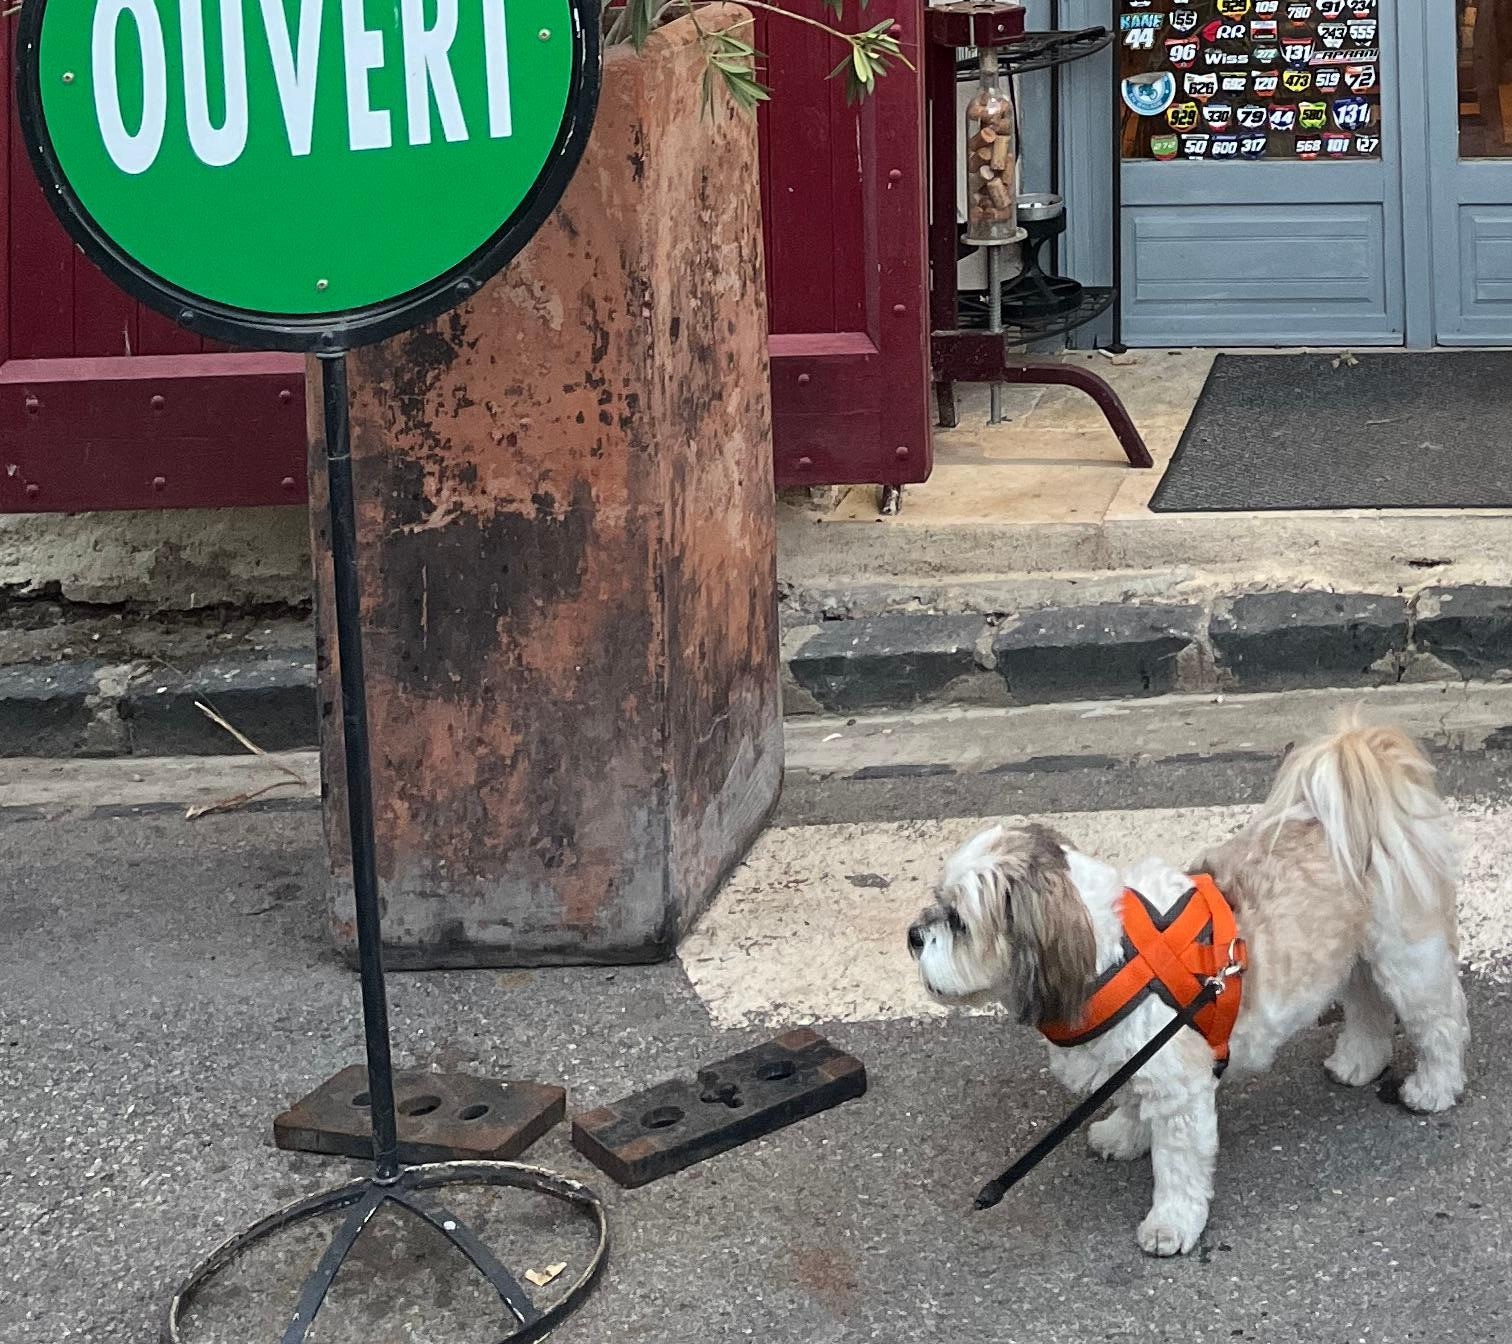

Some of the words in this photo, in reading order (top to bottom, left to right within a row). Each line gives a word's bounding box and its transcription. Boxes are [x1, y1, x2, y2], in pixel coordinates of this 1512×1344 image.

[1321, 1, 1342, 13] 91
[1125, 28, 1154, 49] 44
[1216, 25, 1246, 39] RR
[1169, 44, 1197, 62] 96
[1284, 45, 1311, 60] 131
[1285, 75, 1310, 87] 473
[1315, 73, 1341, 87] 519
[1348, 73, 1373, 88] 72
[1189, 82, 1215, 94] 626
[1171, 110, 1196, 125] 929
[1240, 110, 1264, 123] 79
[1270, 111, 1294, 123] 44
[1337, 103, 1368, 124] 131
[1185, 140, 1208, 153] 50
[1240, 138, 1266, 152] 317
[1327, 139, 1350, 152] 101
